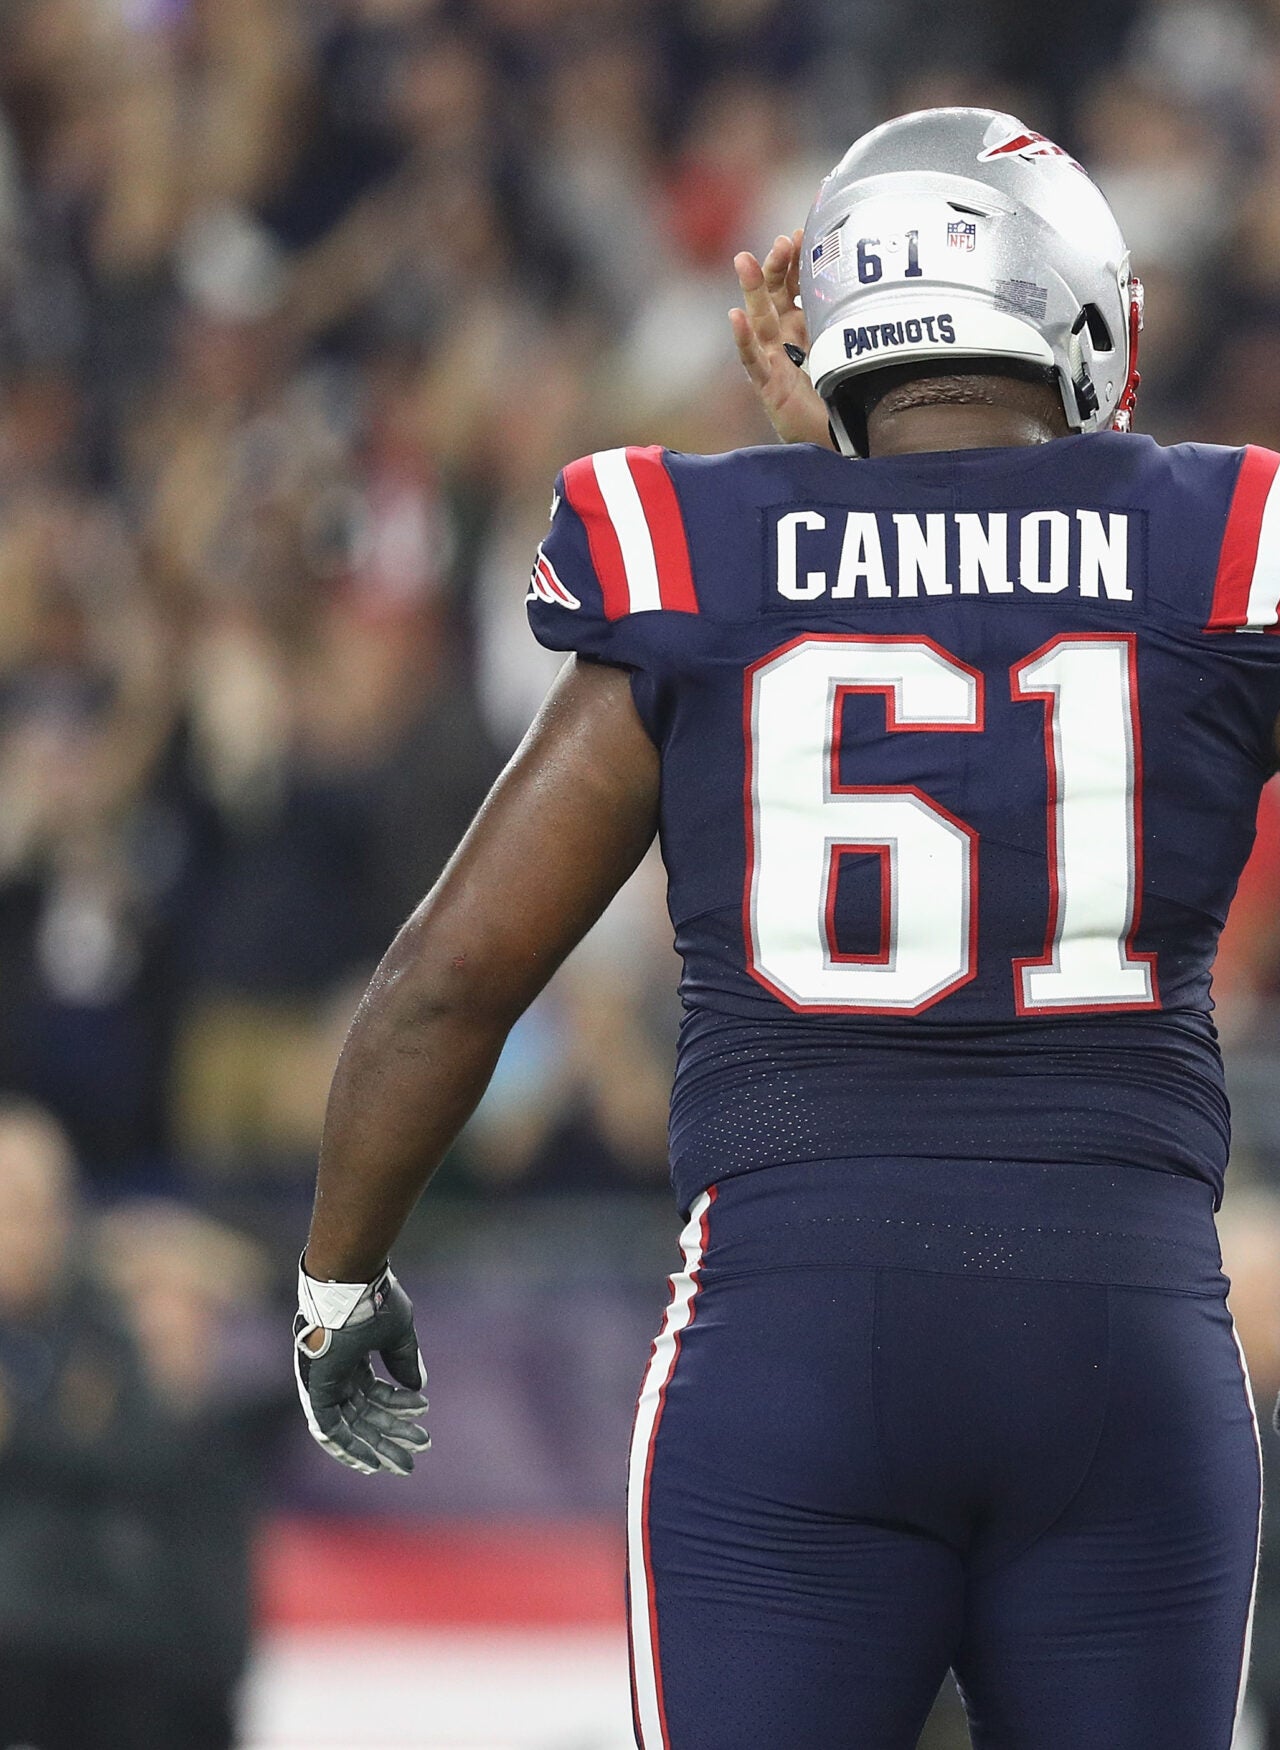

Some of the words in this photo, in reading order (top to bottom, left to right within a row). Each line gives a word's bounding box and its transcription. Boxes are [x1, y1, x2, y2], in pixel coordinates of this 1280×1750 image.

[857, 230, 922, 284] 61
[950, 234, 972, 249] NFL
[843, 314, 955, 359] PATRIOTS
[776, 510, 1133, 601] CANNON
[743, 632, 1162, 1016] 61
